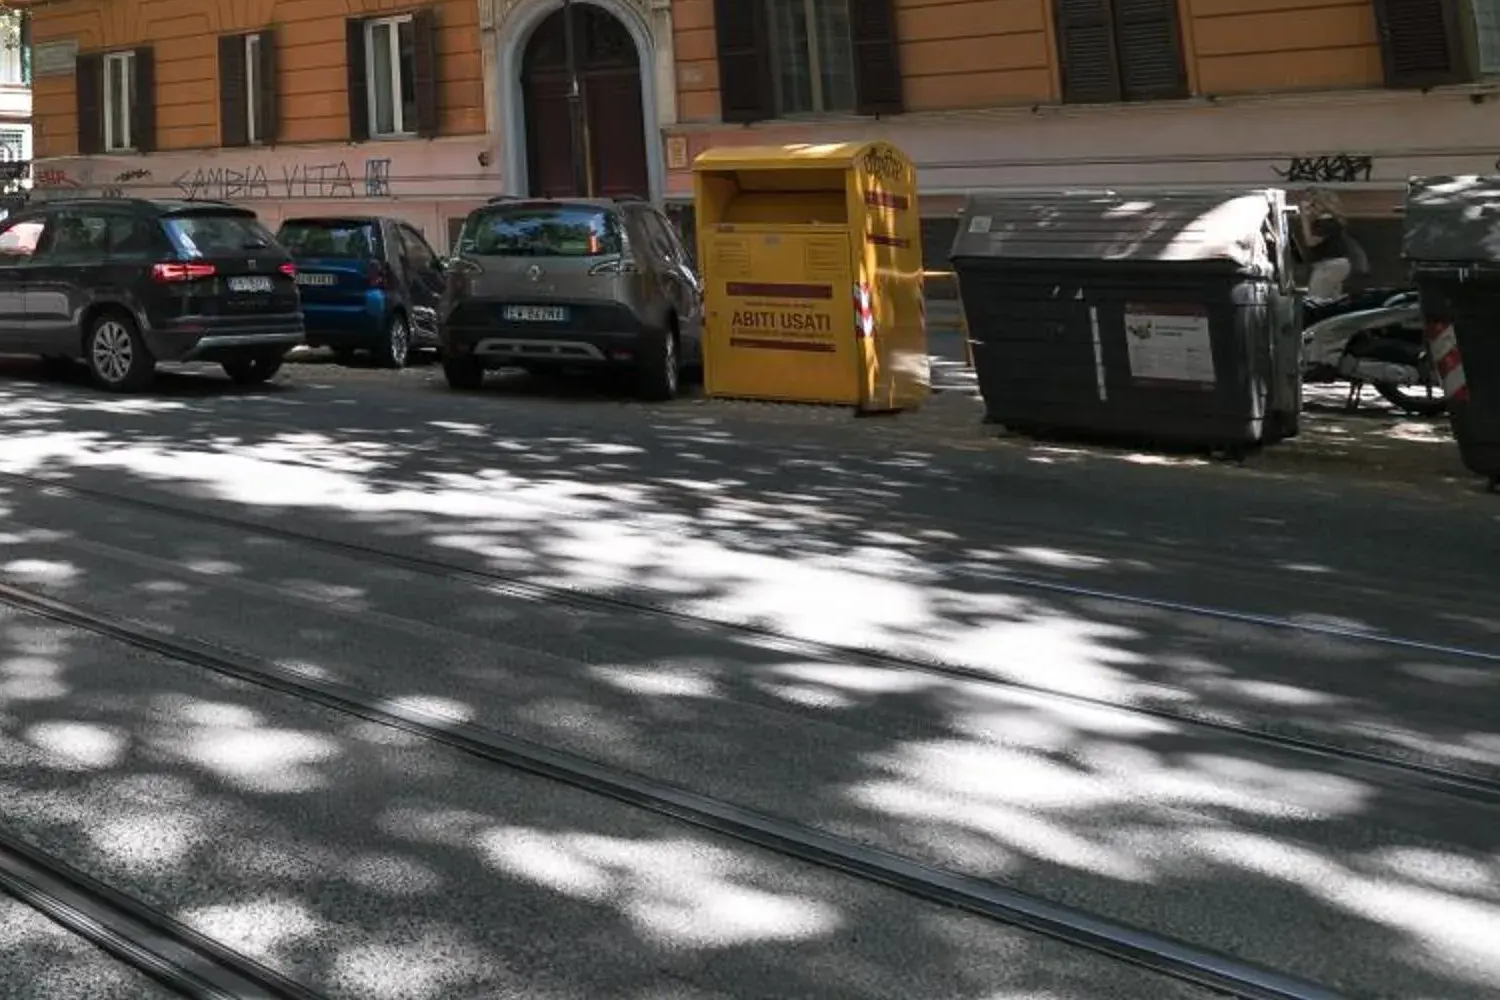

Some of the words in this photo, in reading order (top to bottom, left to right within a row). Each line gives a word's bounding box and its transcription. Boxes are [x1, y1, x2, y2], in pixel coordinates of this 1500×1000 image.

[283, 159, 356, 199] VITA
[731, 311, 776, 328] ABITI
[781, 311, 831, 331] USATI
